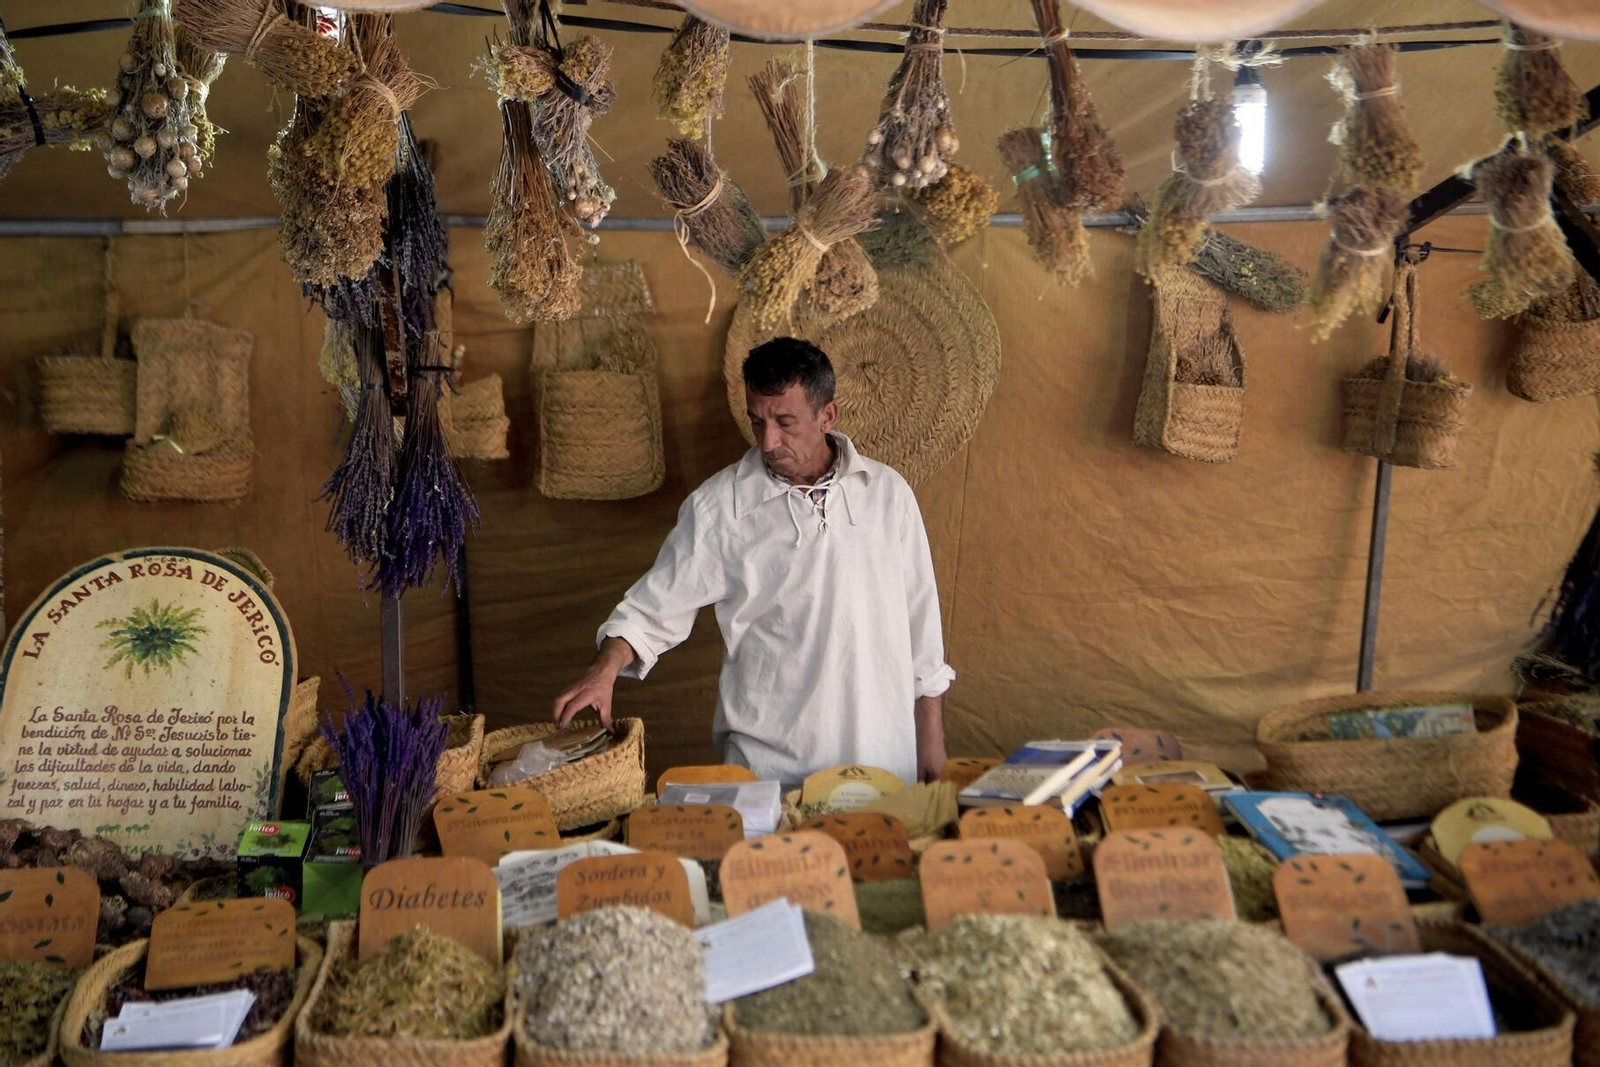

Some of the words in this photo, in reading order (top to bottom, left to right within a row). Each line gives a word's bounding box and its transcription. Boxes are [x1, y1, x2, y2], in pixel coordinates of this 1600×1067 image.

[23, 631, 50, 659] LA
[47, 571, 123, 625] SANTA
[128, 562, 193, 580] ROSA
[200, 570, 229, 592] DE
[28, 706, 48, 723] La
[53, 706, 98, 722] Santa
[101, 705, 142, 726] Rosa
[147, 709, 164, 723] de
[168, 708, 214, 725] Jericó
[216, 715, 238, 731] por
[242, 711, 255, 726] la
[21, 725, 86, 740] bendición
[91, 726, 109, 739] de
[159, 727, 228, 742] Jesucristo
[233, 727, 256, 741] tie-
[18, 743, 34, 756] ne
[38, 742, 52, 756] la
[57, 743, 98, 756] virtud
[102, 744, 119, 756] de
[121, 744, 169, 762] ayudar
[171, 747, 182, 758] a
[185, 743, 252, 757] solucionar
[14, 760, 34, 773] las
[38, 758, 116, 777] dificultades
[119, 760, 134, 773] de
[139, 760, 153, 773] la
[157, 761, 190, 774] vida,
[193, 760, 236, 773] dando
[63, 777, 105, 792] salud,
[107, 778, 150, 793] dinero,
[153, 777, 214, 792] habilidad
[219, 777, 252, 792] labo-
[7, 795, 25, 808] ral
[26, 799, 36, 815] y
[39, 799, 63, 815] paz
[68, 799, 84, 808] en
[88, 794, 102, 808] tu
[106, 794, 145, 815] hogar
[148, 799, 157, 816] y
[160, 799, 169, 809] a
[173, 794, 187, 809] tu
[188, 795, 242, 815] familia.
[575, 864, 647, 886] Sordera
[656, 864, 666, 885] y
[368, 883, 487, 911] Diabetes
[574, 889, 671, 912] Zumbidos
